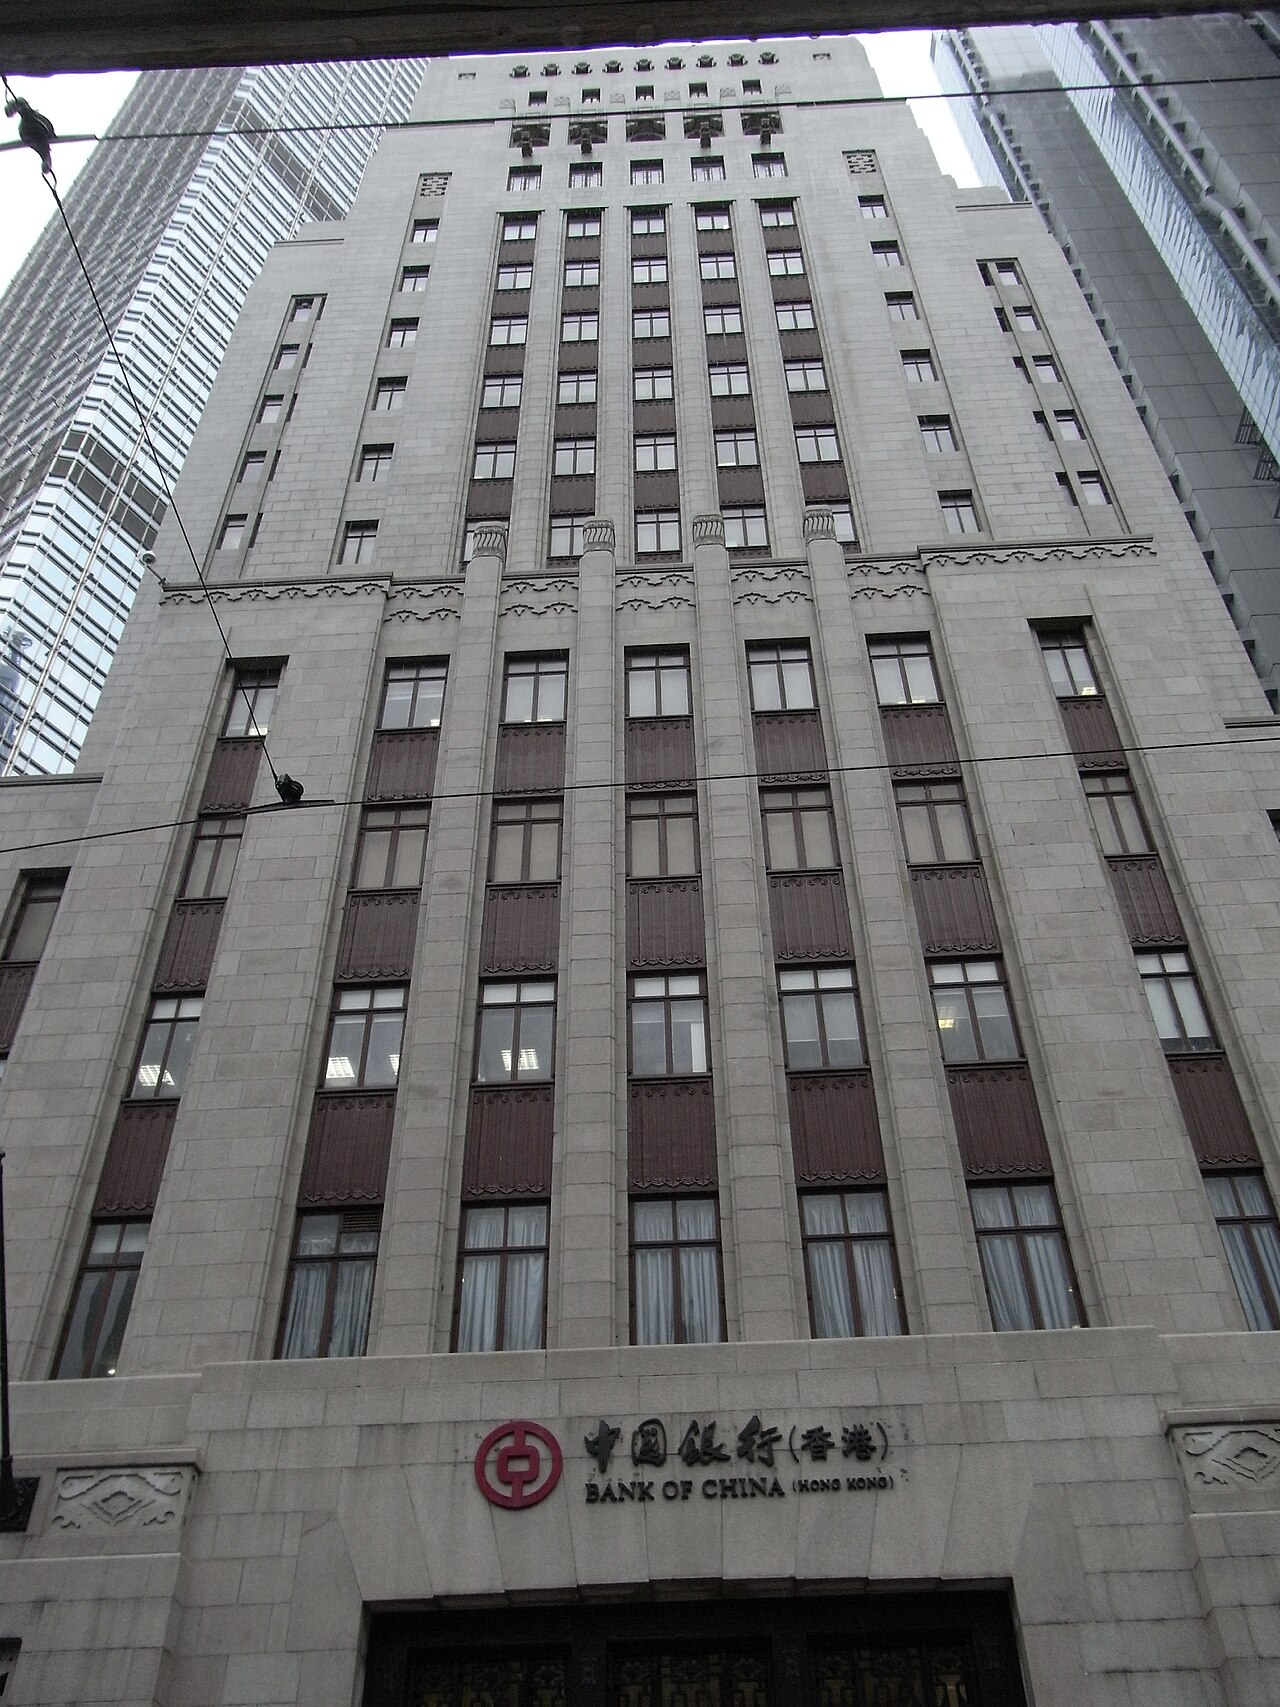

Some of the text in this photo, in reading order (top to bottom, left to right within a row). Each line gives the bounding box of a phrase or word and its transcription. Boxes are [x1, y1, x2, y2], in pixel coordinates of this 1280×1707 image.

[585, 1475, 894, 1503] BANK OF CHINA (HONG KONG)
